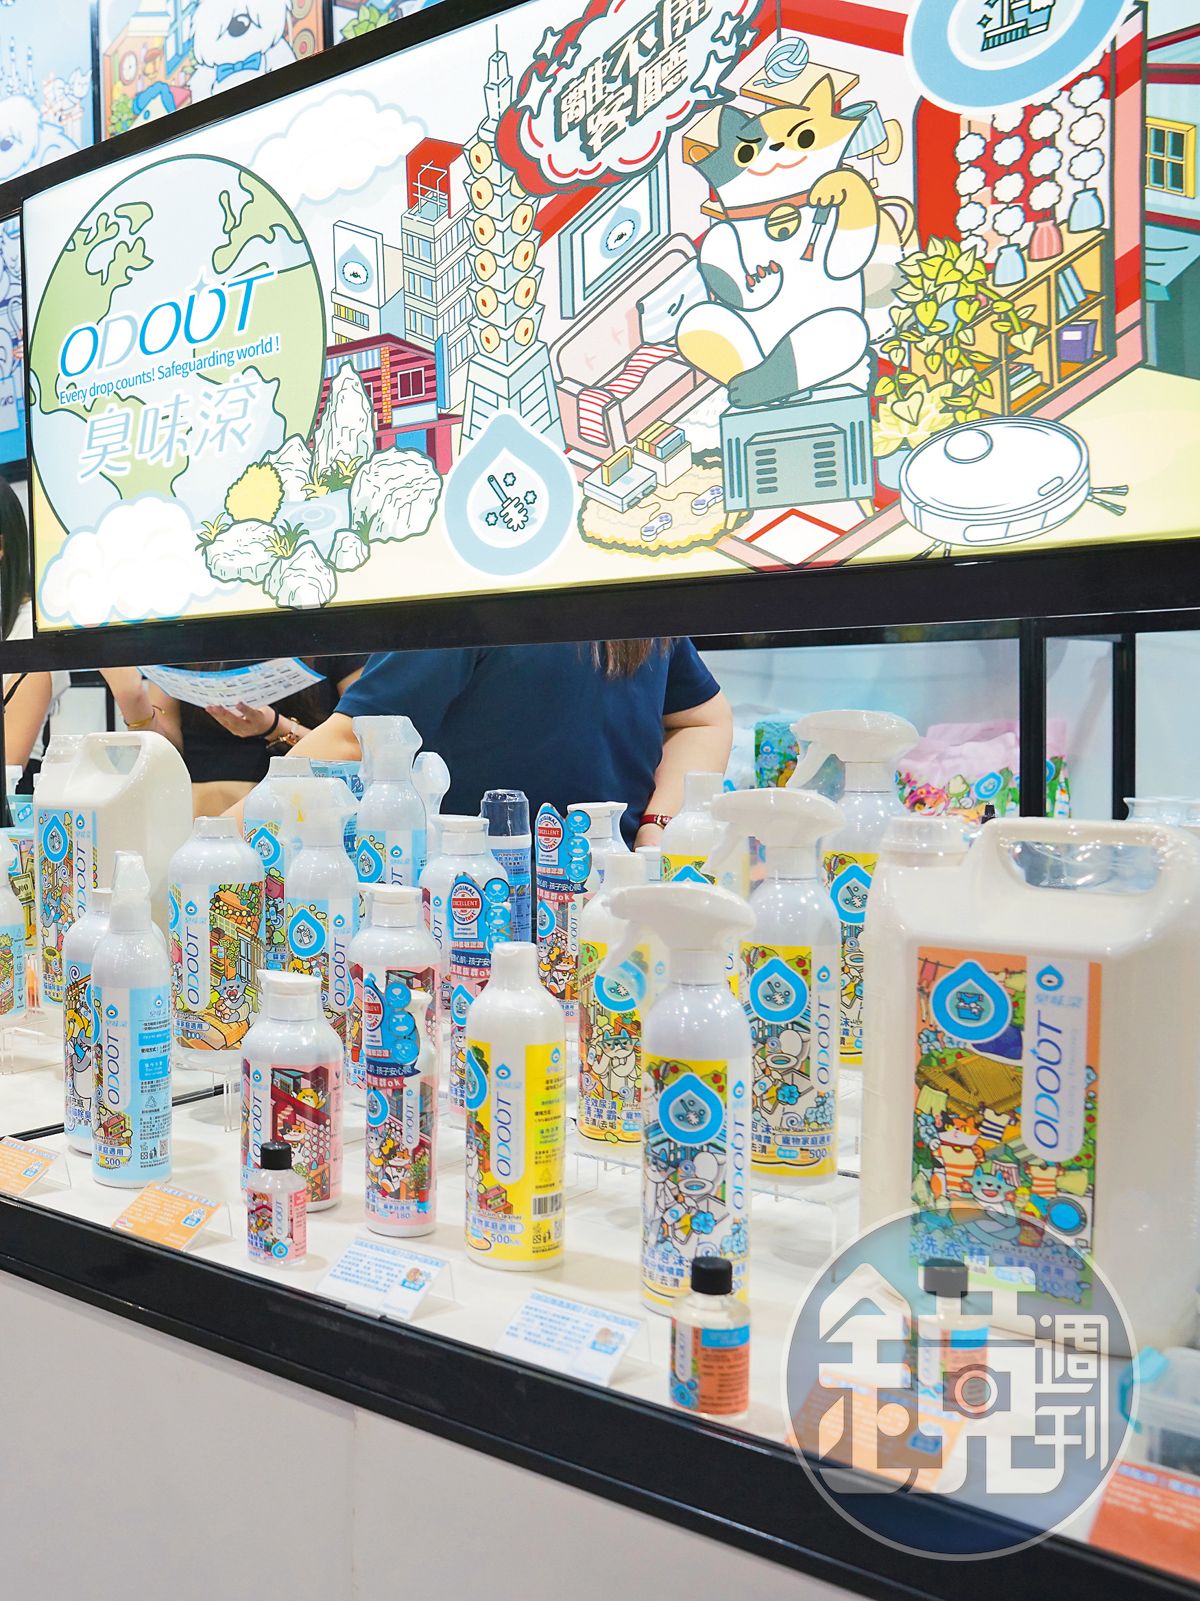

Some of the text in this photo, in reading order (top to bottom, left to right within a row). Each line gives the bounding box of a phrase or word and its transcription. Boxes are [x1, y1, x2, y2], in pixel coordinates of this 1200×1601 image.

[60, 271, 274, 377] ODOUT
[59, 389, 88, 405] Every
[89, 381, 115, 399] drop
[116, 368, 156, 391] counts!
[157, 348, 235, 380] Safeguarding
[237, 337, 273, 360] world
[80, 378, 259, 480] 臭味滾
[106, 1029, 120, 1105] ODOUT
[1030, 1010, 1063, 1149] ODOUT
[105, 1156, 122, 1167] 500
[496, 1096, 512, 1177] ODOUT
